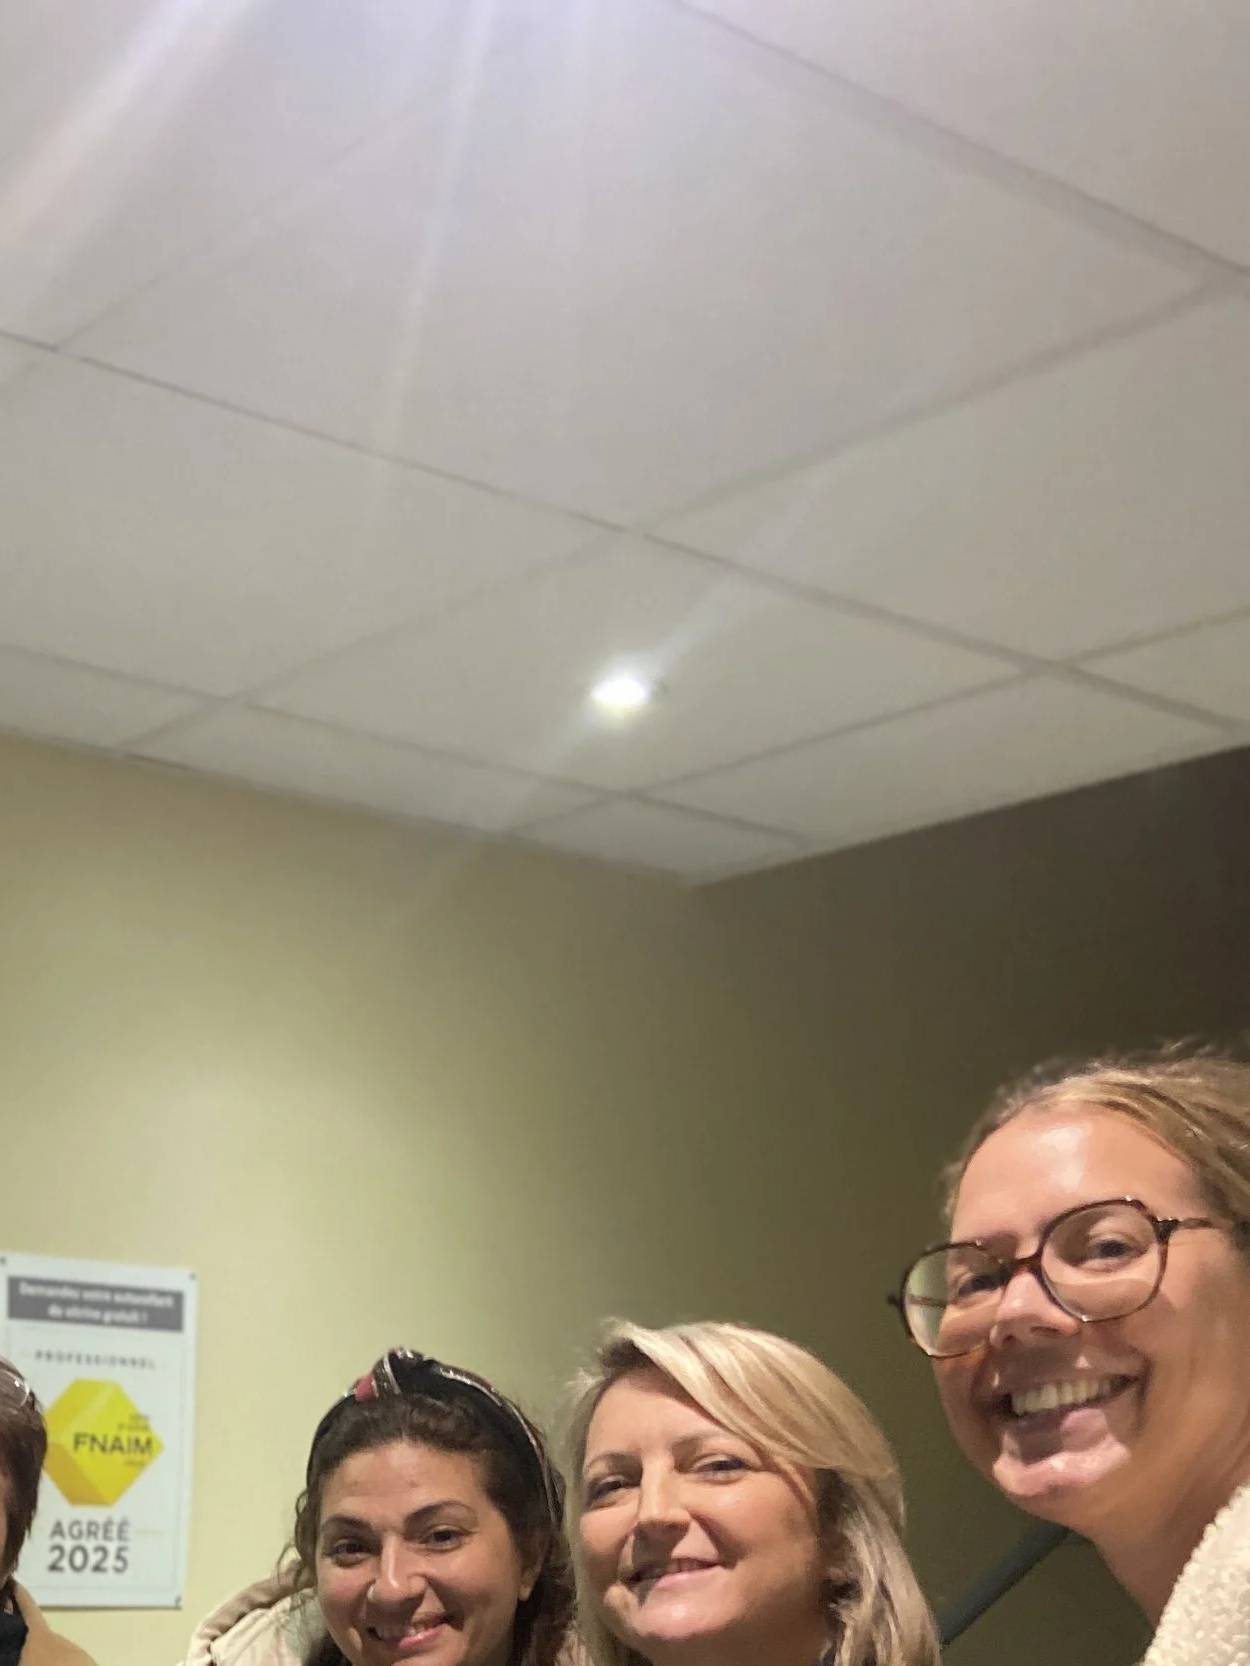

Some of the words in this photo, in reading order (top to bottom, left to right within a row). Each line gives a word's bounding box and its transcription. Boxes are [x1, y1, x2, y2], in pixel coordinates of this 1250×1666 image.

[35, 1350, 156, 1370] PROFESSIONNEL
[73, 1433, 152, 1456] FNAIM
[50, 1516, 130, 1541] AGRÉÉ
[48, 1547, 129, 1574] 2025
